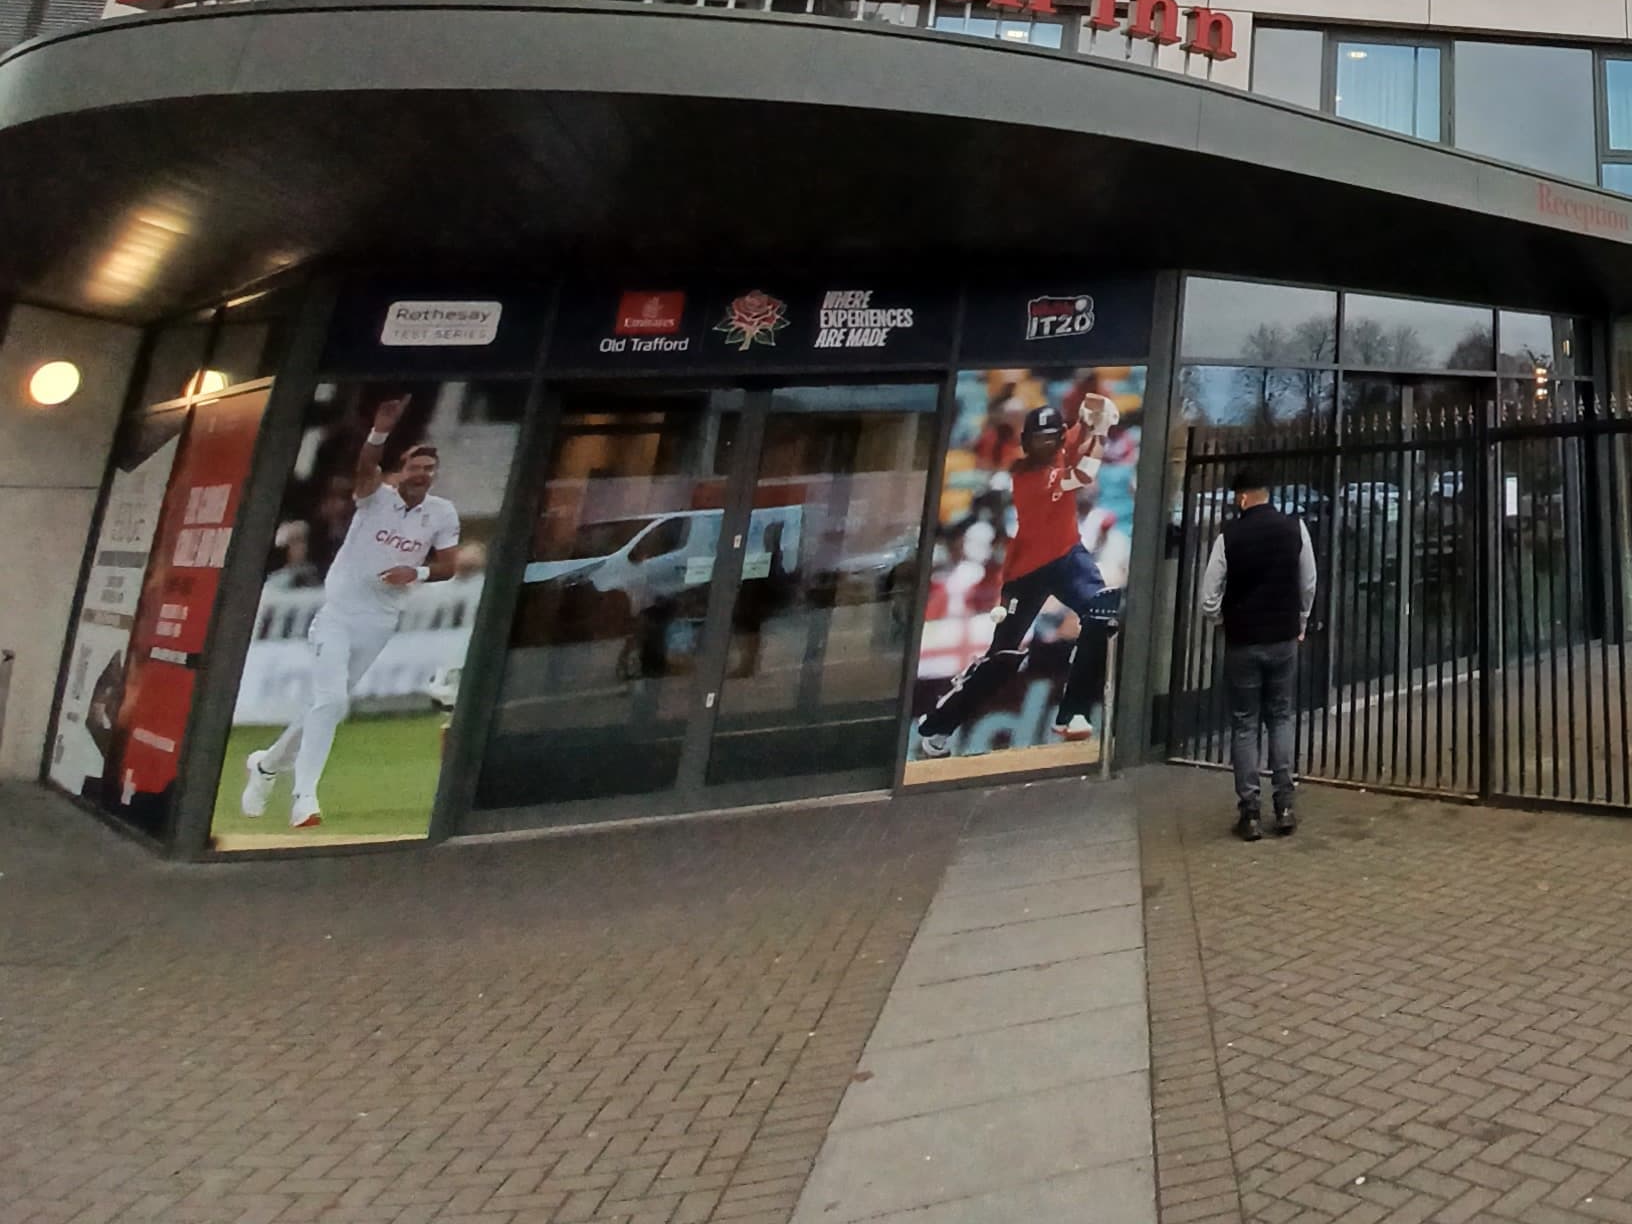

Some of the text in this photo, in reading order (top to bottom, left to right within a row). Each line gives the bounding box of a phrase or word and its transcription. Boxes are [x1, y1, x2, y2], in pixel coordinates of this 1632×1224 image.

[1536, 182, 1629, 232] Reception
[822, 290, 874, 309] WHERE
[396, 308, 491, 323] Rothesay
[820, 308, 914, 328] EXPERIENCES
[600, 337, 690, 352] Old Trafford
[814, 327, 892, 348] ARE MADE
[375, 529, 423, 553] cinch
